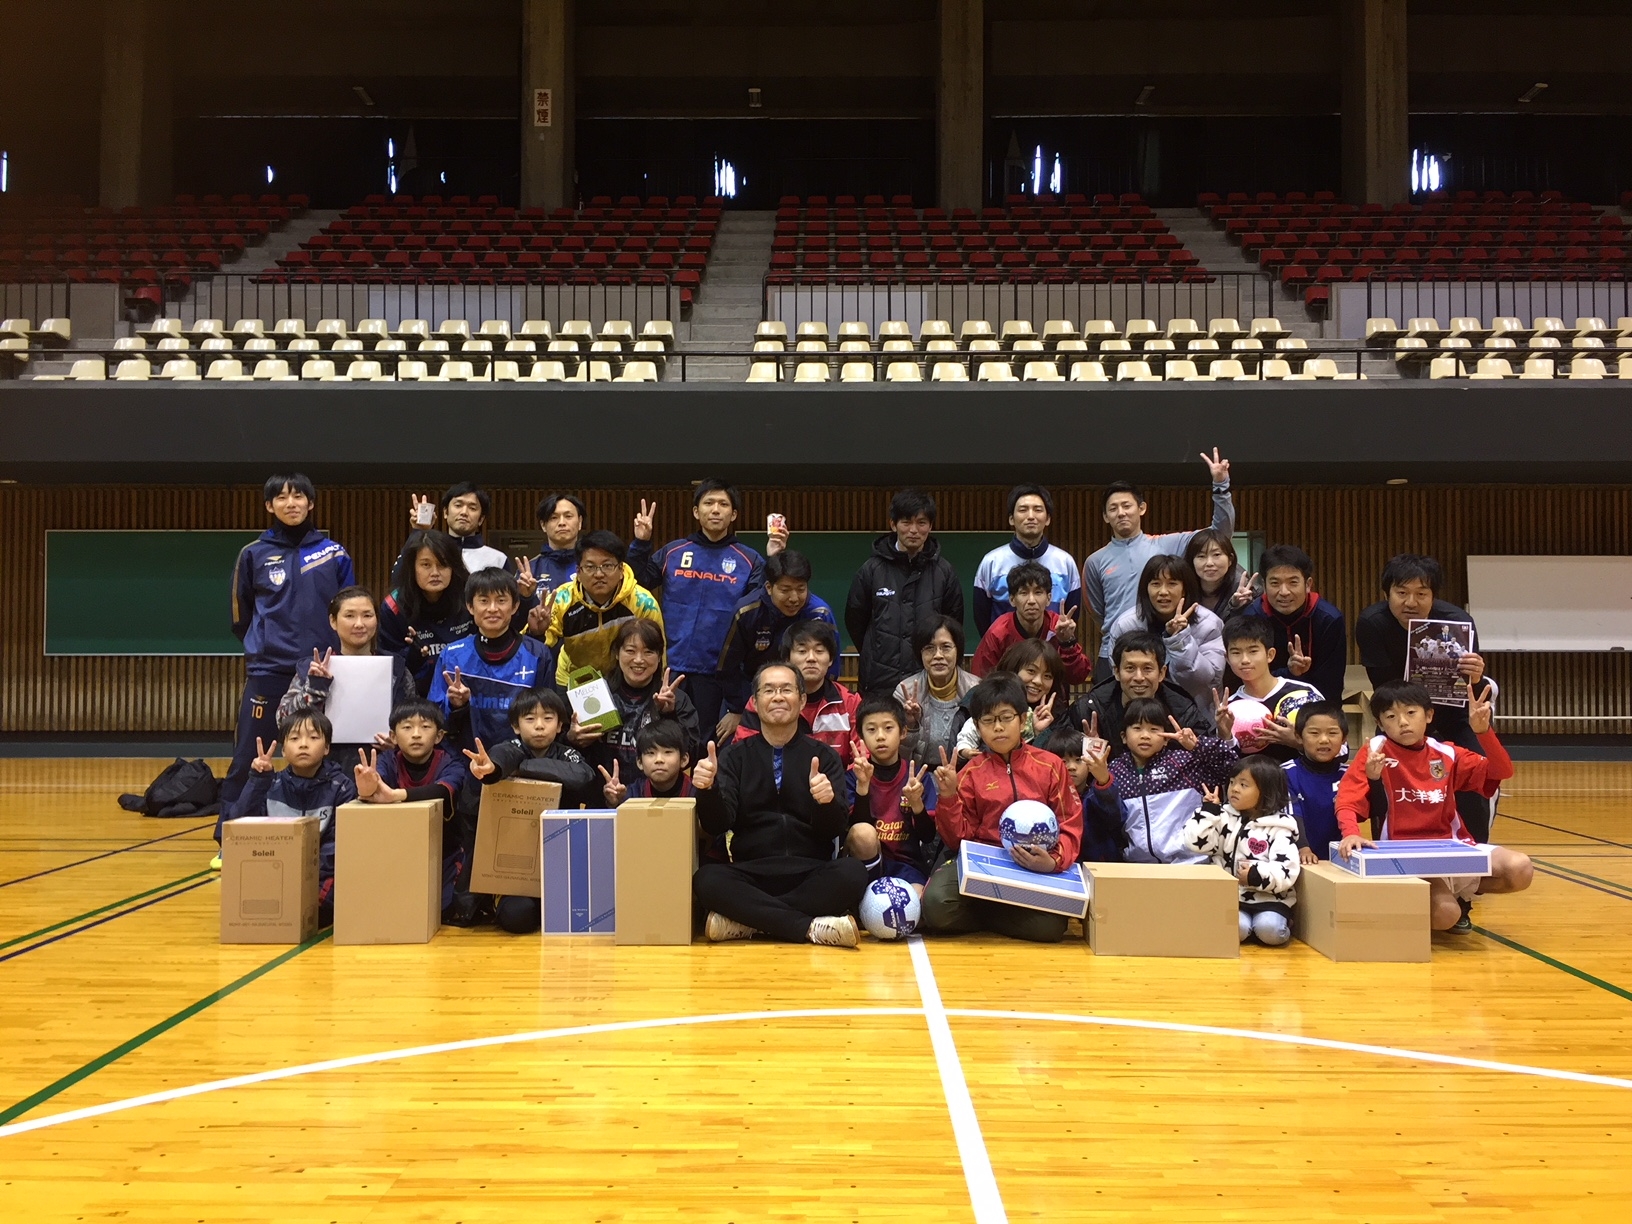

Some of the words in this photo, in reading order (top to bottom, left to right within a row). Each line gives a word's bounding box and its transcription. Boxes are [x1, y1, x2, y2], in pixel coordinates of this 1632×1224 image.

[536, 91, 549, 124] 禁煙
[680, 551, 693, 568] 6
[674, 569, 737, 584] PENALTY
[574, 684, 599, 698] MELON
[251, 705, 263, 719] 10
[492, 792, 524, 800] CERAMIC
[511, 807, 534, 816] Soleil
[875, 819, 904, 832] Qatar
[252, 849, 275, 857] Soleil
